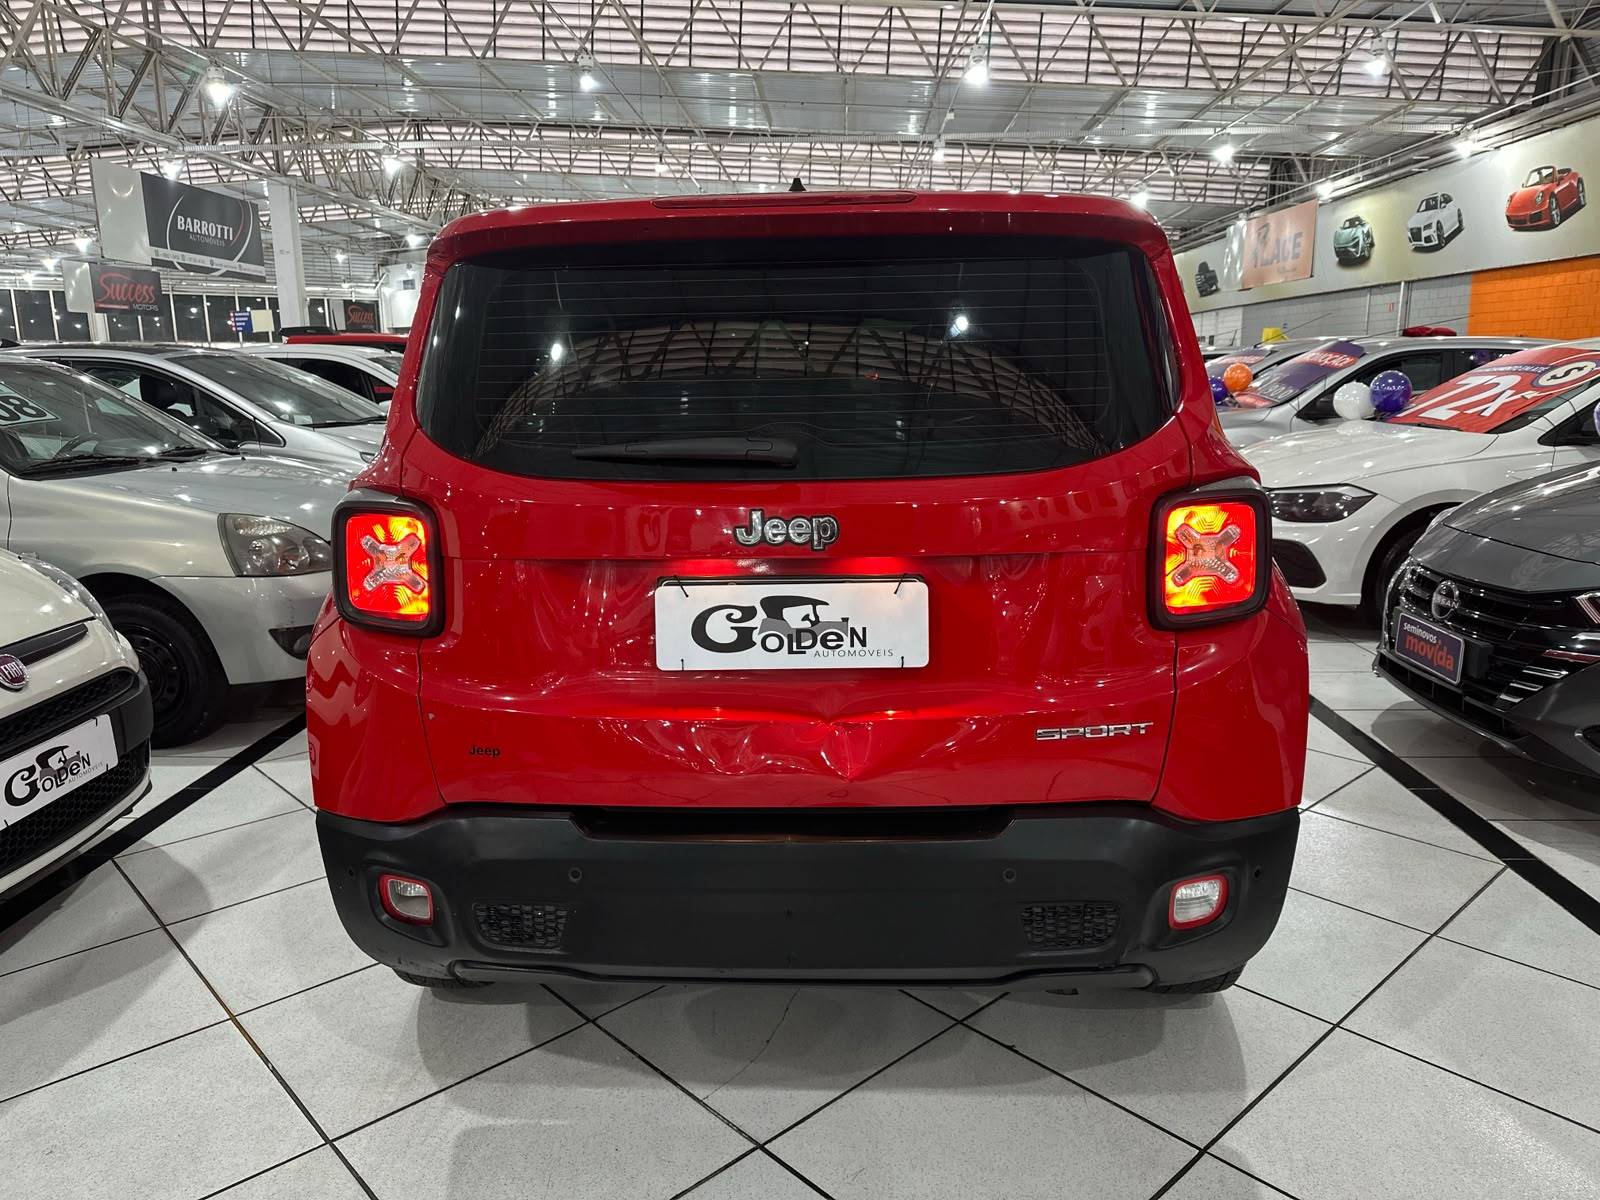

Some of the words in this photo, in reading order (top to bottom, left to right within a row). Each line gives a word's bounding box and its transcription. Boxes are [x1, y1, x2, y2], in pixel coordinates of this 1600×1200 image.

[177, 215, 233, 241] BARROTTI
[97, 272, 156, 303] Success
[132, 303, 159, 311] MOTORS
[735, 508, 839, 550] Jeep
[1403, 621, 1437, 643] seminovos
[813, 648, 894, 659] AUTOMÓVEIS
[1405, 634, 1455, 672] movida
[0, 661, 23, 680] FIAT
[1036, 721, 1154, 741] SPORT
[469, 744, 501, 759] Jeep
